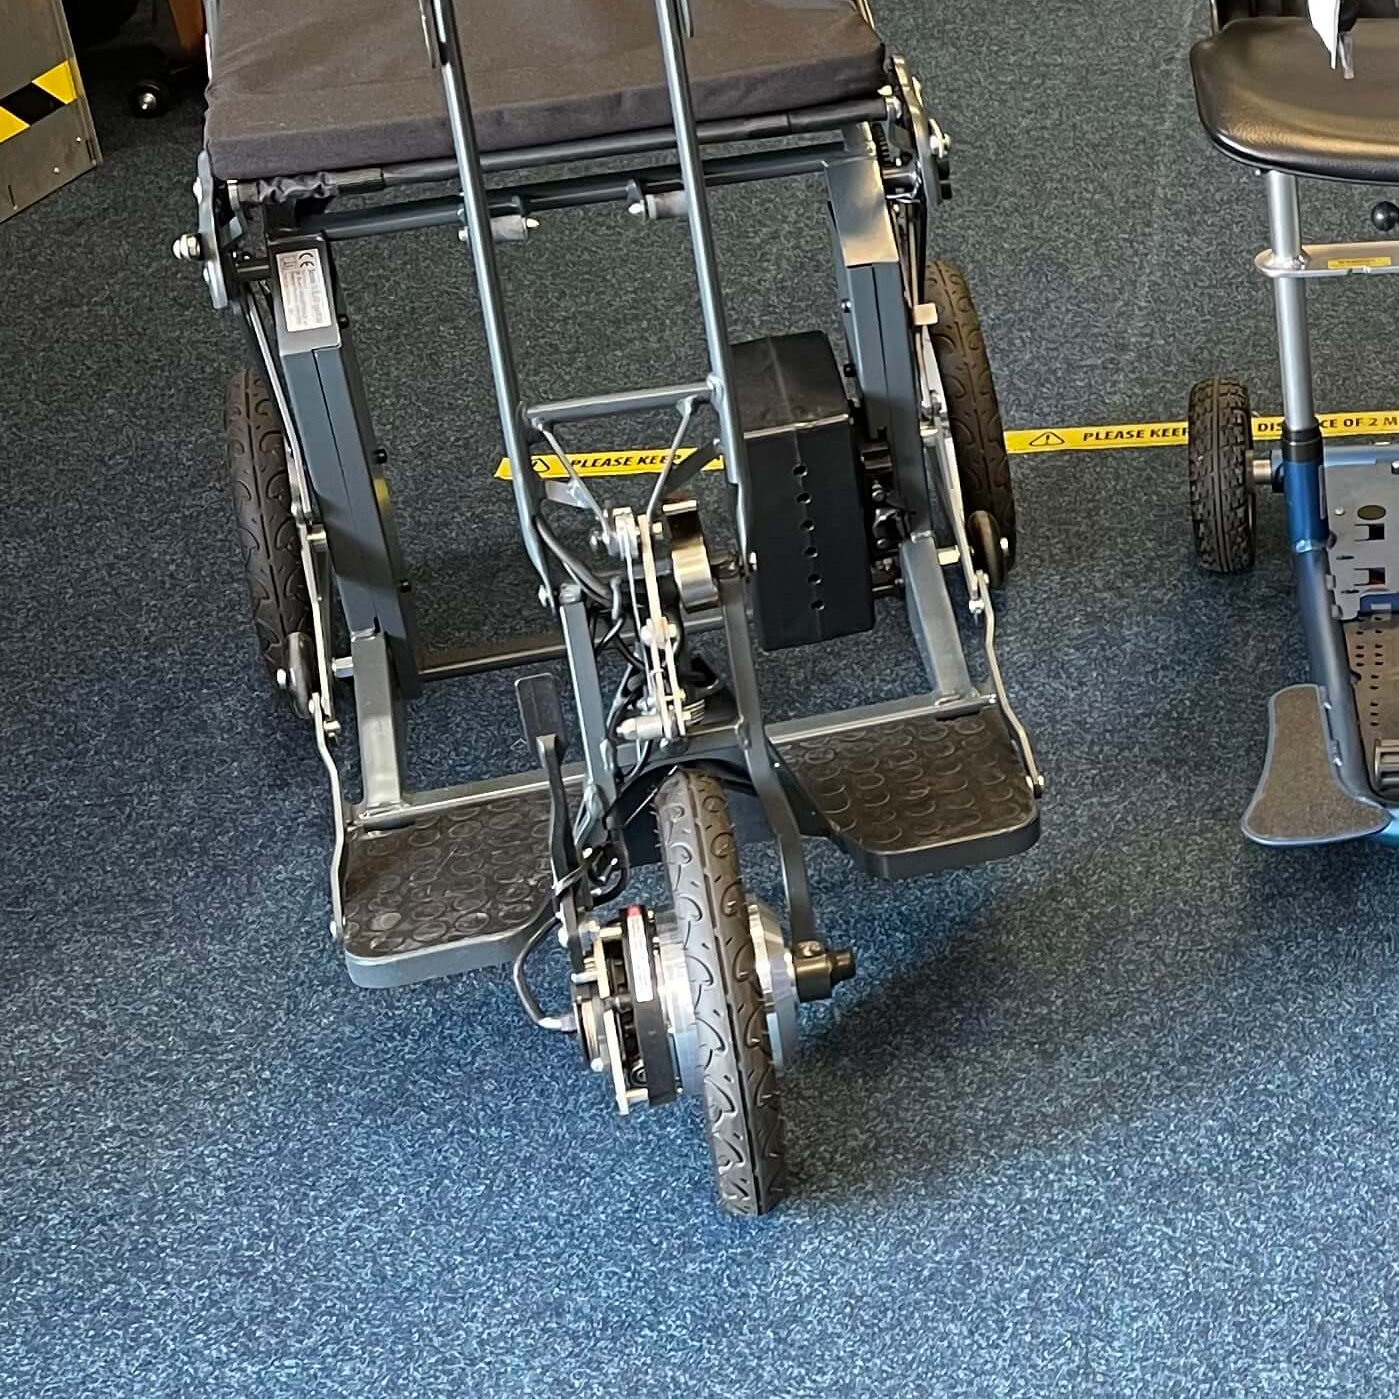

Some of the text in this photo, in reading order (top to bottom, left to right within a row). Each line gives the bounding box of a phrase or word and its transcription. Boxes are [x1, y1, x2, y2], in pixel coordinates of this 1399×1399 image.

[1082, 428, 1145, 442] PLEASE
[1343, 417, 1366, 428] OF
[1368, 416, 1379, 427] 2
[570, 453, 632, 468] PLEASE
